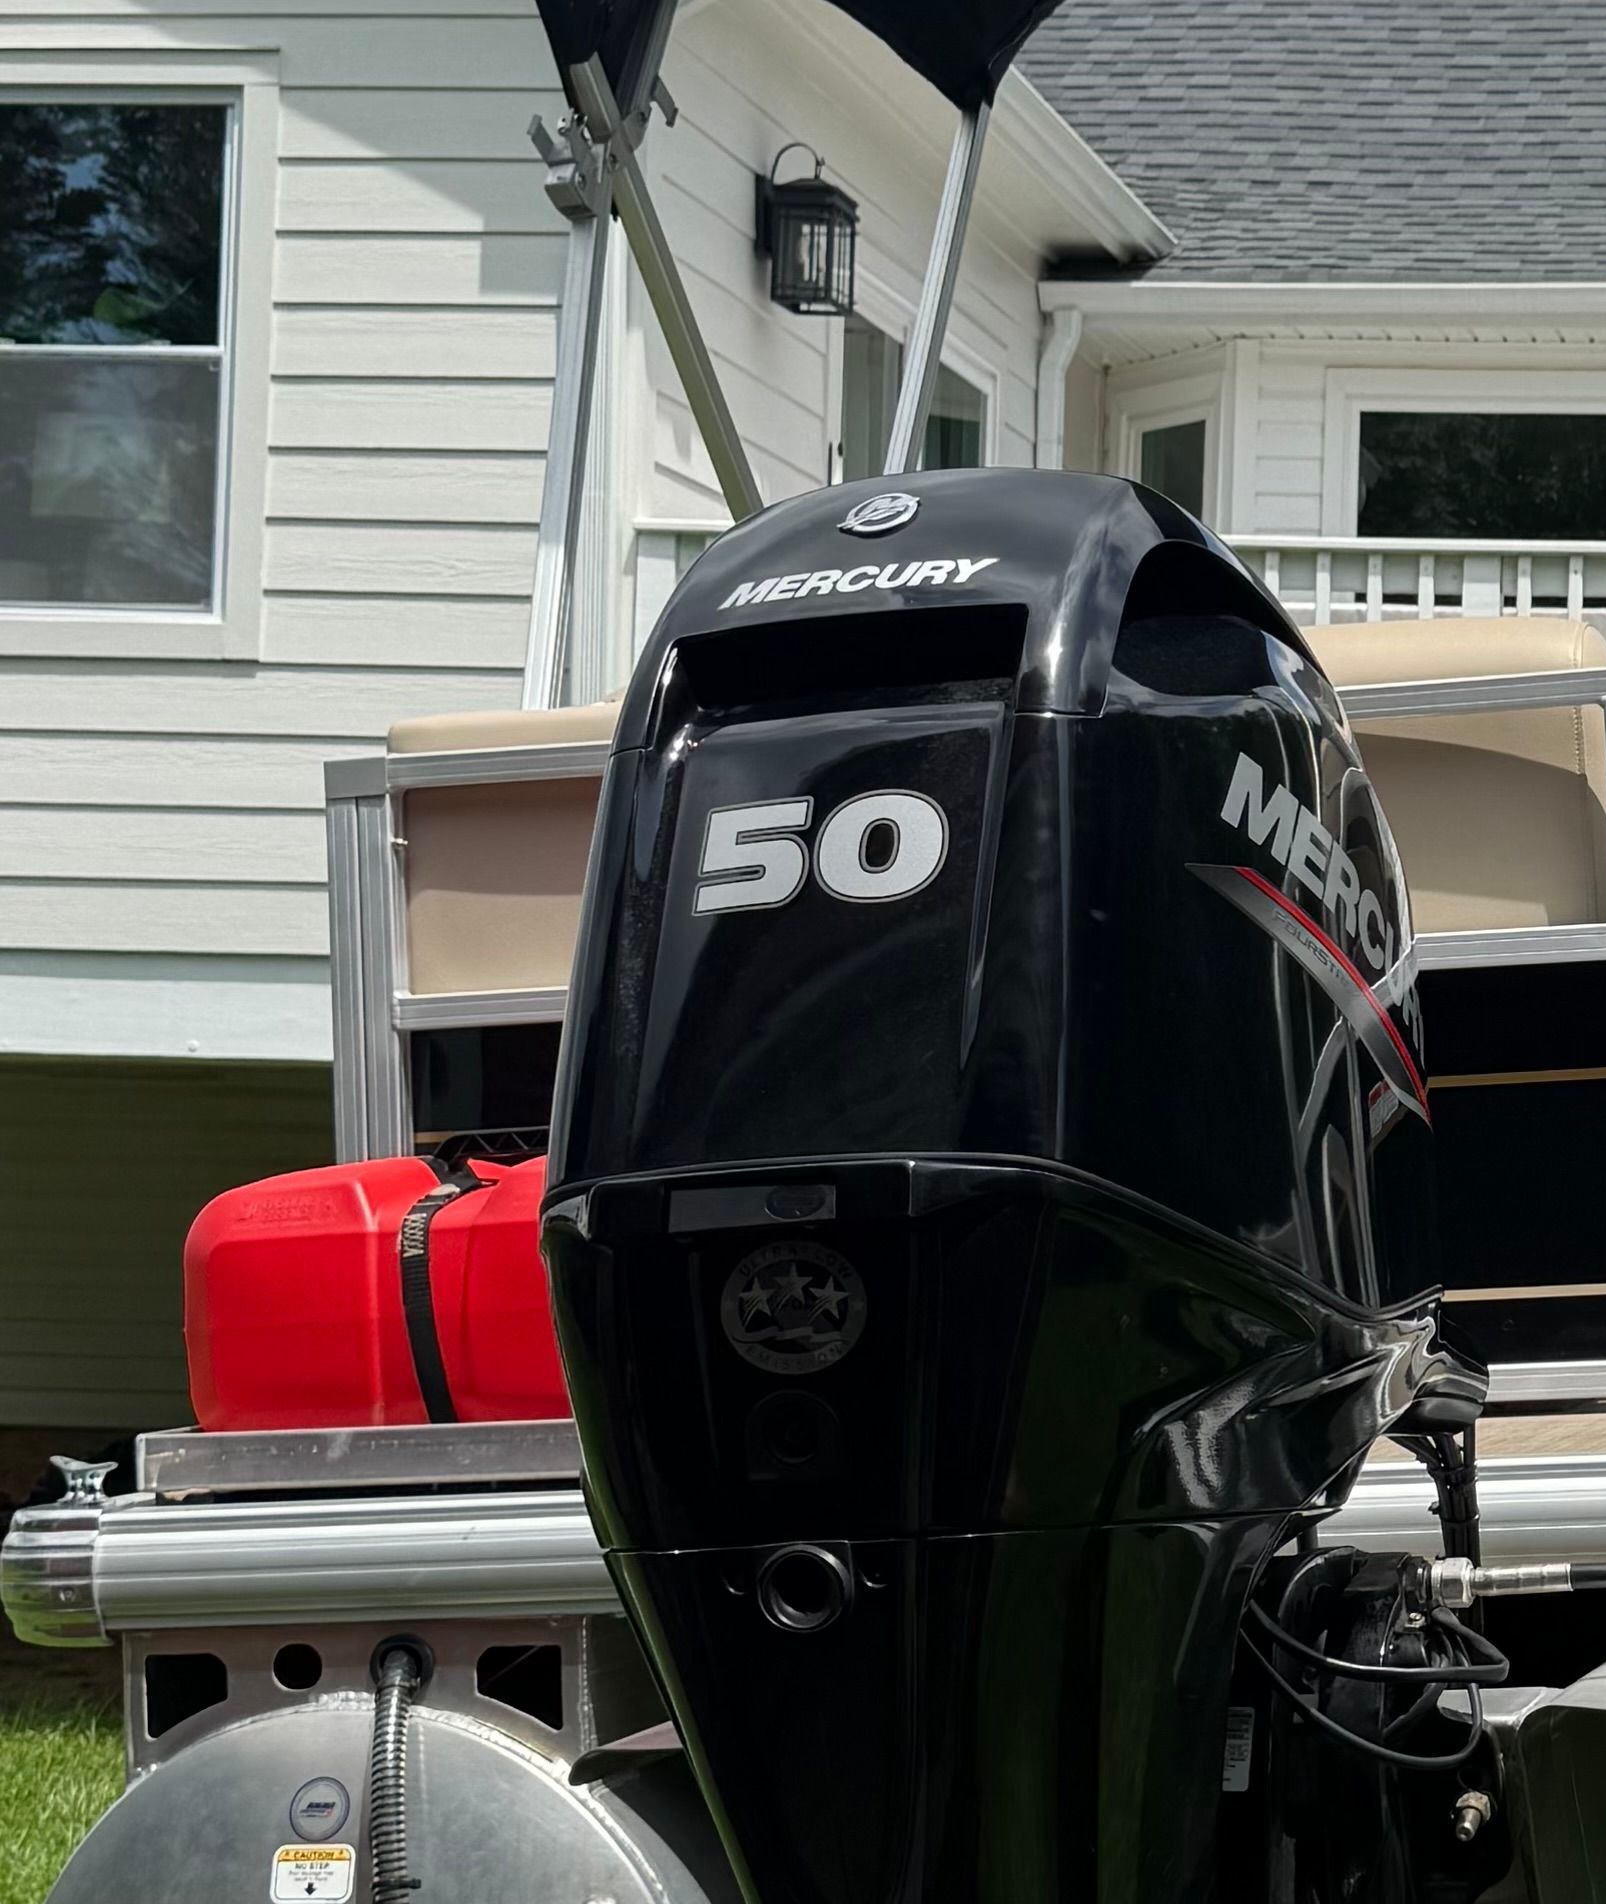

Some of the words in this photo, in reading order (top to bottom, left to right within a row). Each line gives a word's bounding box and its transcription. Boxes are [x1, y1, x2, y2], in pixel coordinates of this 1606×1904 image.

[717, 558, 999, 610] MERCURY
[692, 788, 950, 916] 50
[293, 1851, 335, 1860] CAUTION
[295, 1862, 307, 1870] NO
